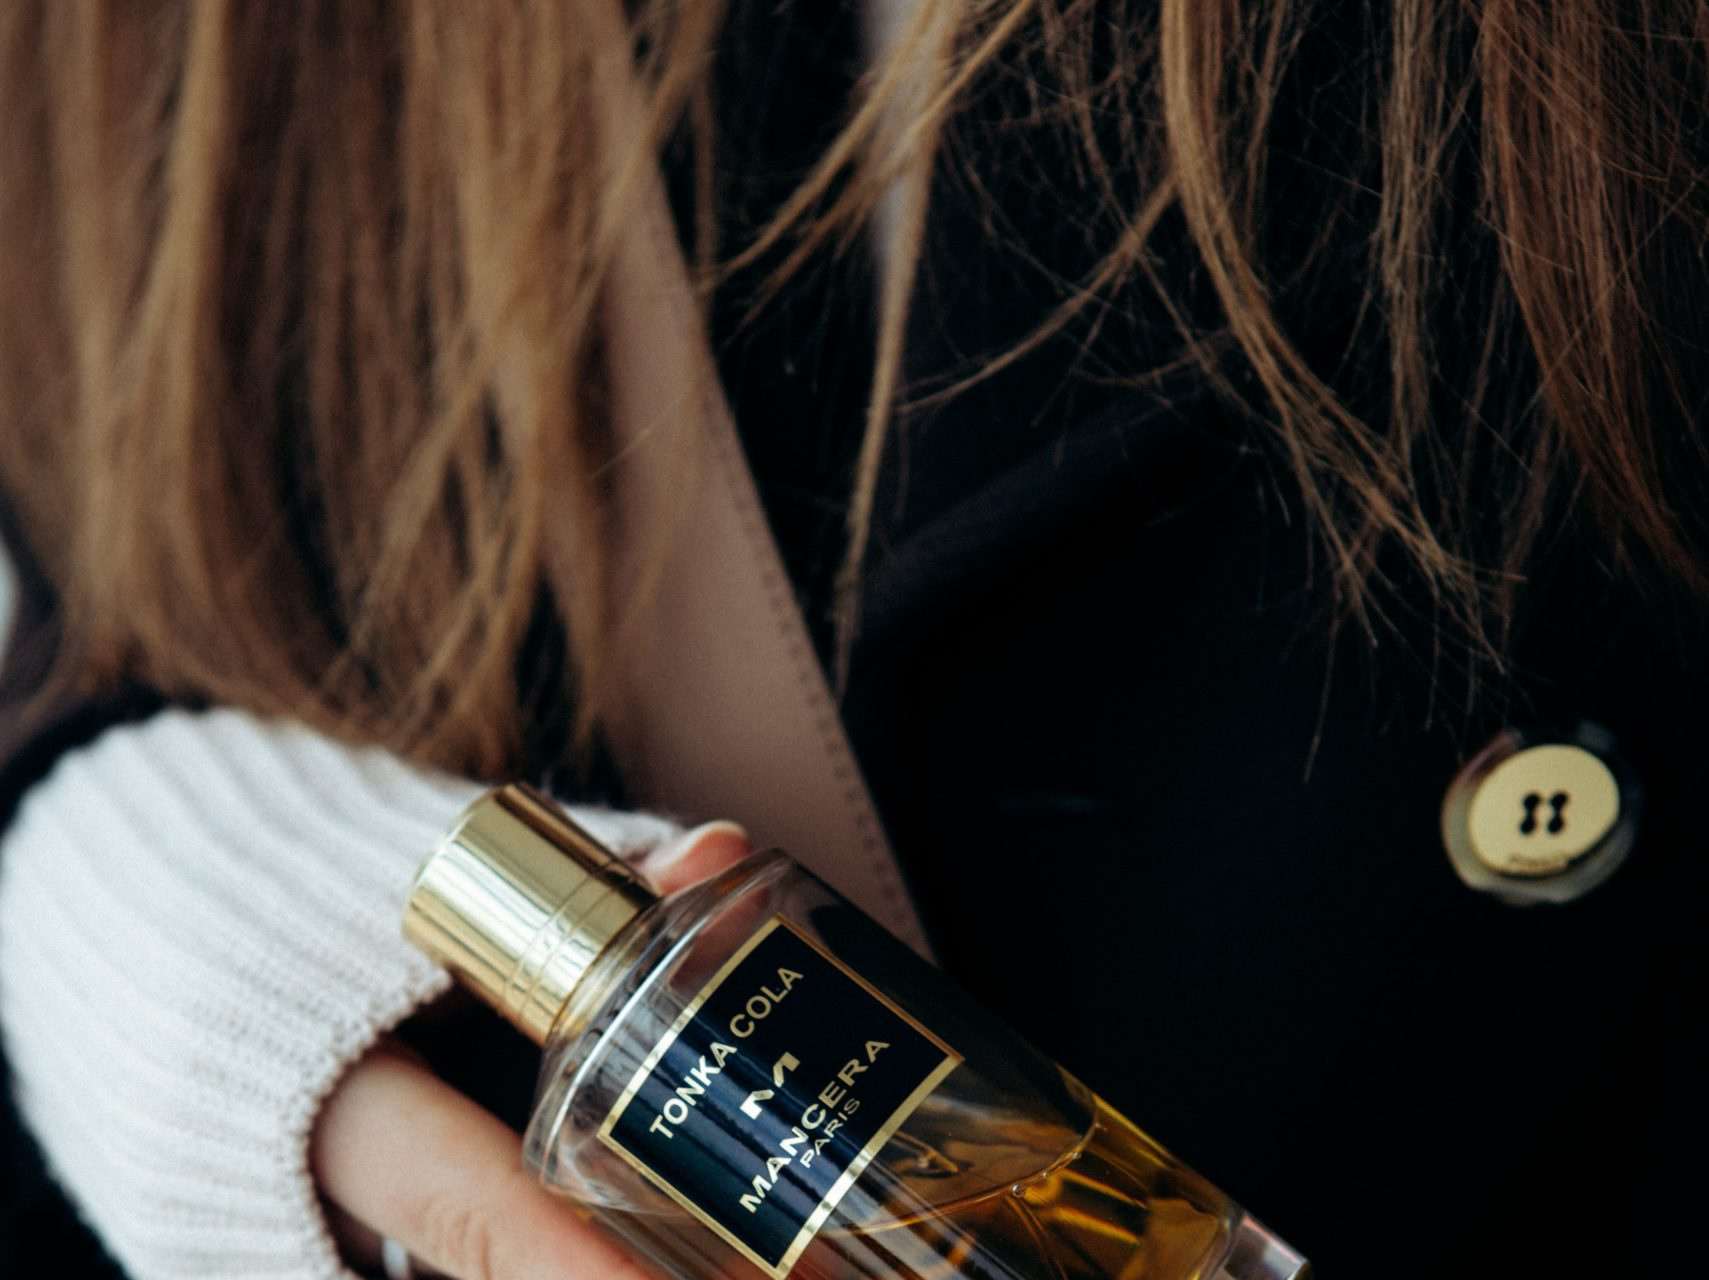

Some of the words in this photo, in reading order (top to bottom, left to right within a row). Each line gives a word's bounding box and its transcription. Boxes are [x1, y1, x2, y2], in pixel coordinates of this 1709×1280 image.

[649, 1040, 738, 1139] TONKA
[730, 967, 804, 1038] COLA
[739, 1040, 890, 1213] MANCERA
[799, 1097, 860, 1168] PARIS
